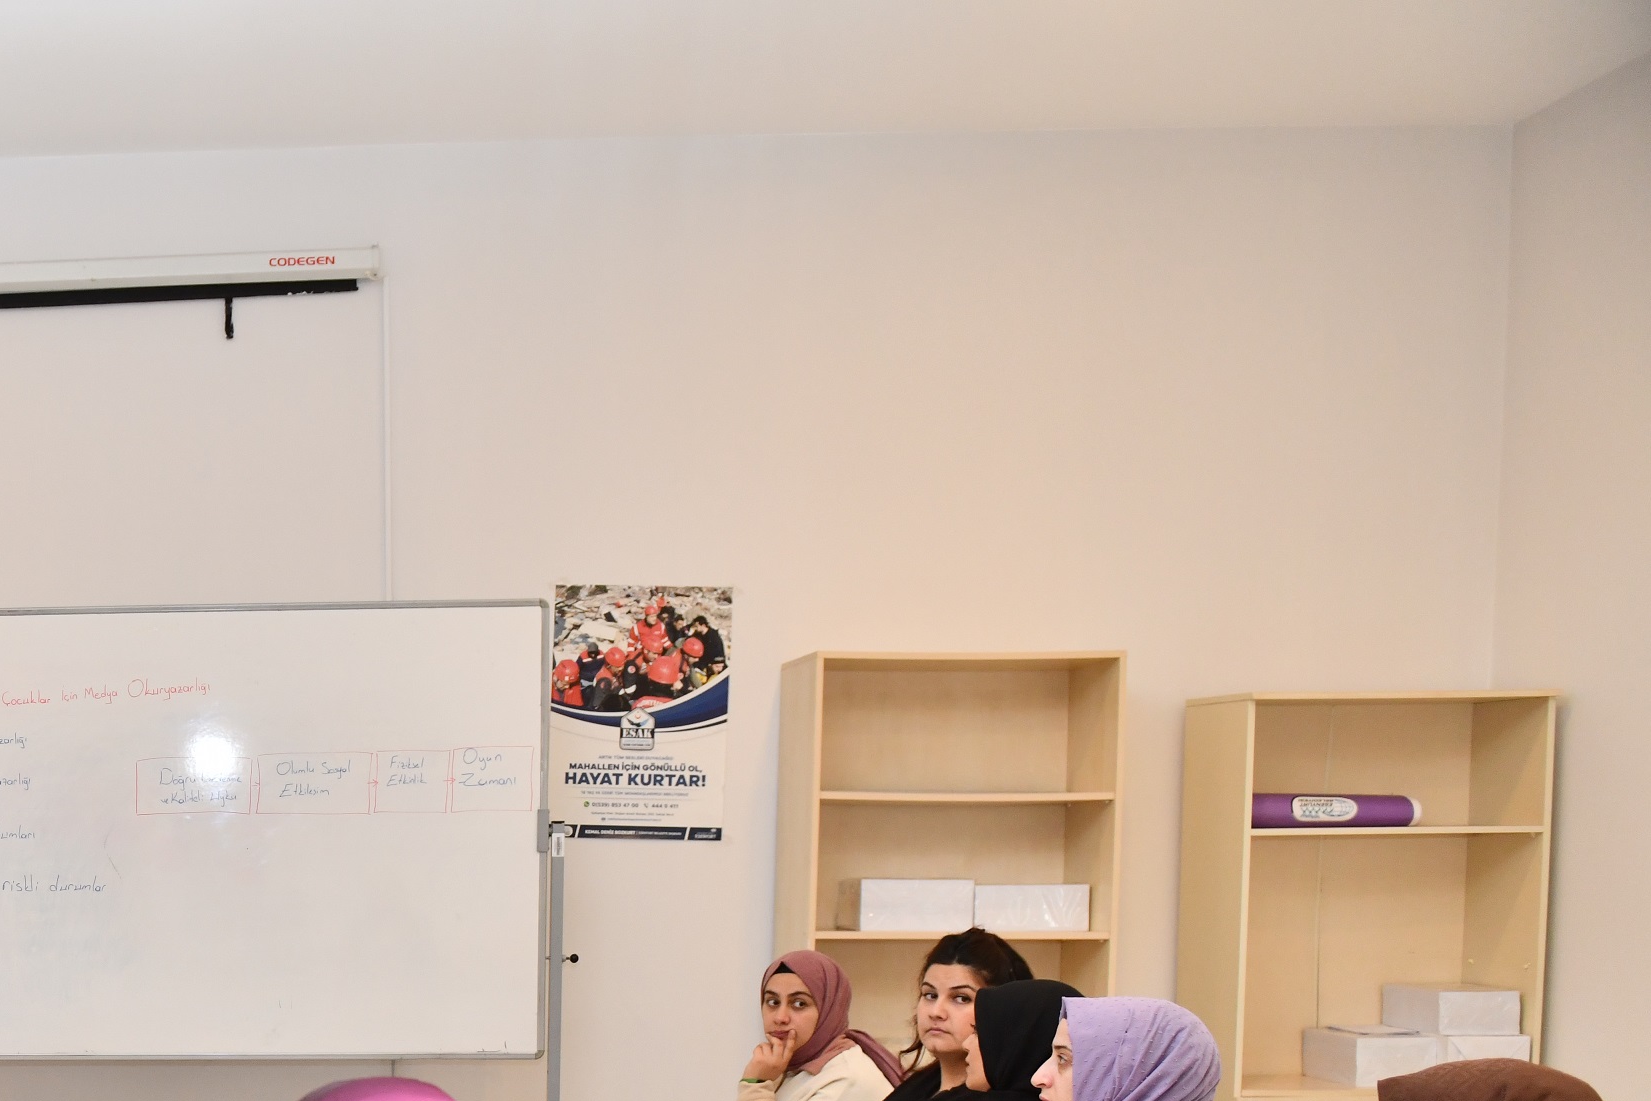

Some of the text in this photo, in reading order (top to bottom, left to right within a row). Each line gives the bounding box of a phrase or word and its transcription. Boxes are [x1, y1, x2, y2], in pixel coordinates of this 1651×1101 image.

[268, 255, 336, 267] CODEGEN
[84, 684, 119, 705] Medya
[621, 727, 654, 738] ESAK
[462, 747, 503, 771] Oyun
[569, 761, 703, 773] MAHALLEN İÇİN GÖNÜLLÜ OL,
[276, 759, 351, 780] Olumlu Sosyal
[564, 771, 707, 788] HAYAT KURTAR!
[1, 874, 39, 892] riskli
[49, 874, 107, 893] durumlar
